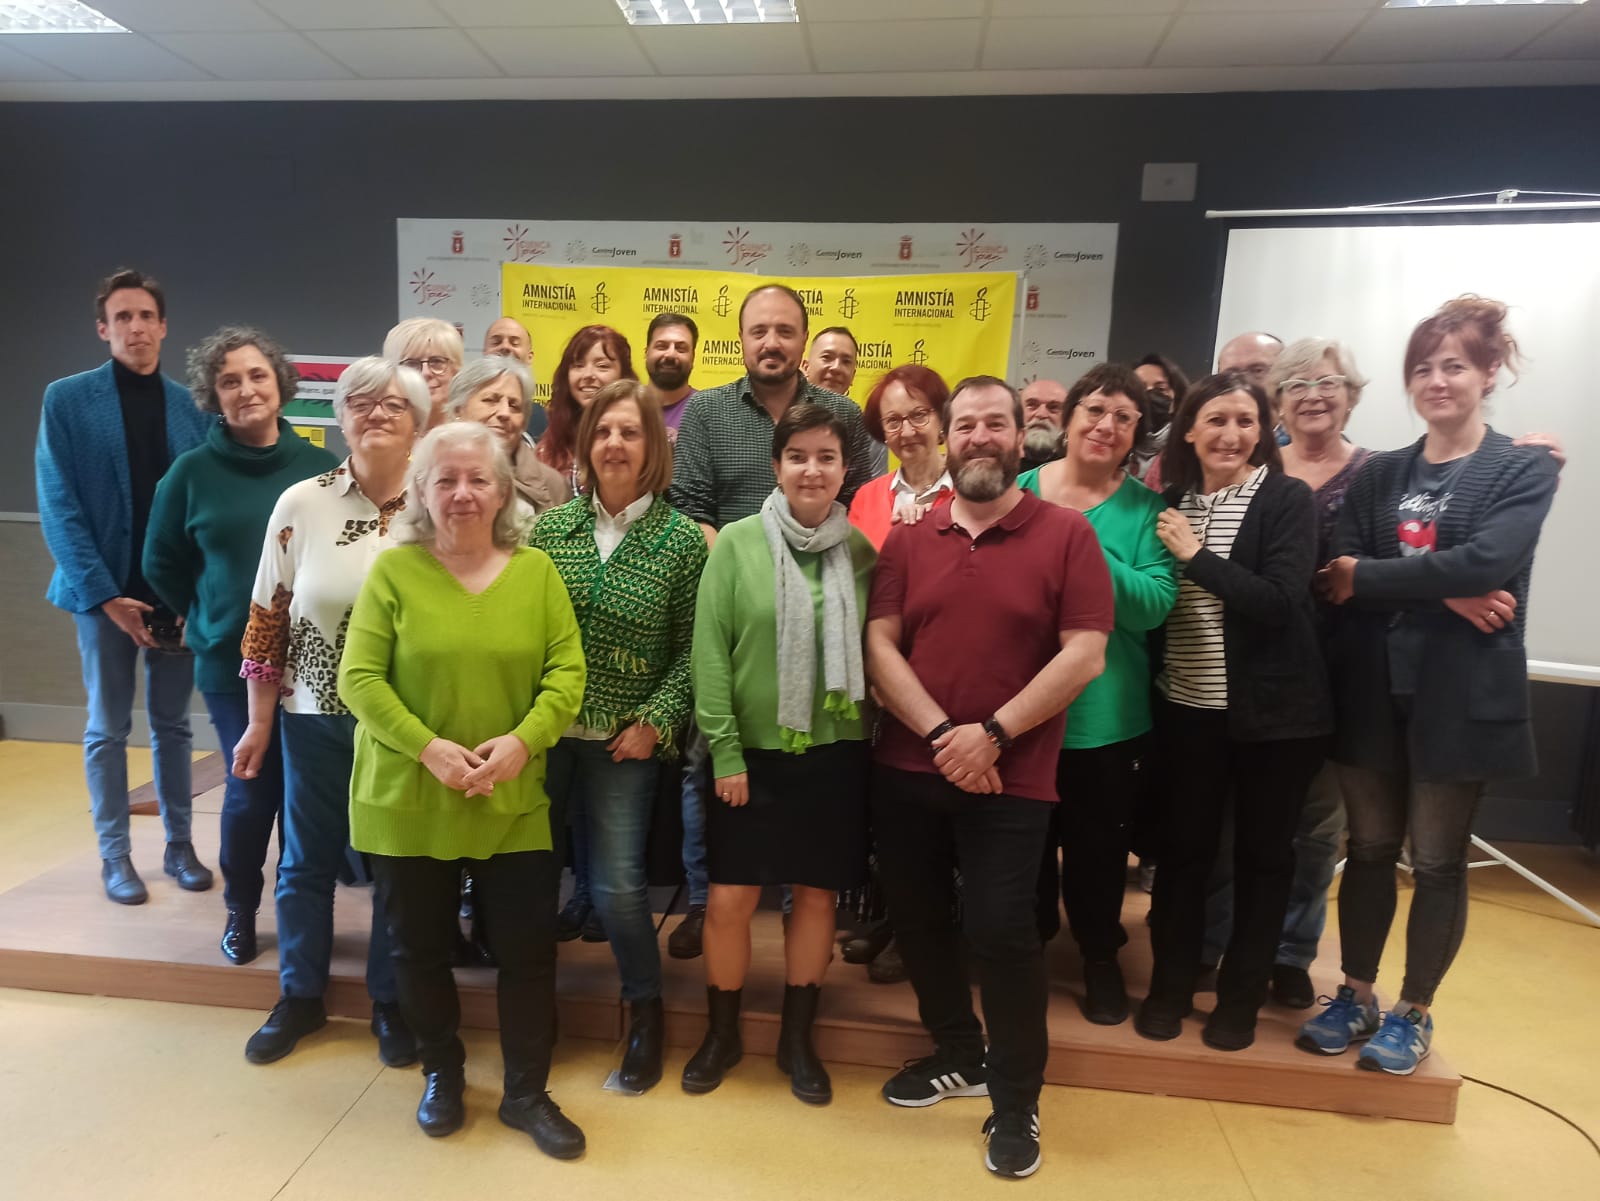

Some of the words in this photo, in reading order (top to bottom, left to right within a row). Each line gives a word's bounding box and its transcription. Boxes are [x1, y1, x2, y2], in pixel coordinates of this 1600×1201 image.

[523, 283, 576, 300] AMNISTÍA
[643, 286, 698, 303] AMNISTÍA
[895, 289, 954, 306] AMNISTÍA
[522, 299, 577, 312] INTERNACIONAL
[643, 303, 699, 314] INTERNACIONAL
[894, 308, 955, 319] INTERNACIONAL
[703, 340, 741, 354] AMNIS
[857, 340, 893, 358] NISTÍA
[702, 356, 745, 366] INTERNACIO
[856, 360, 893, 370] NACIONAL
